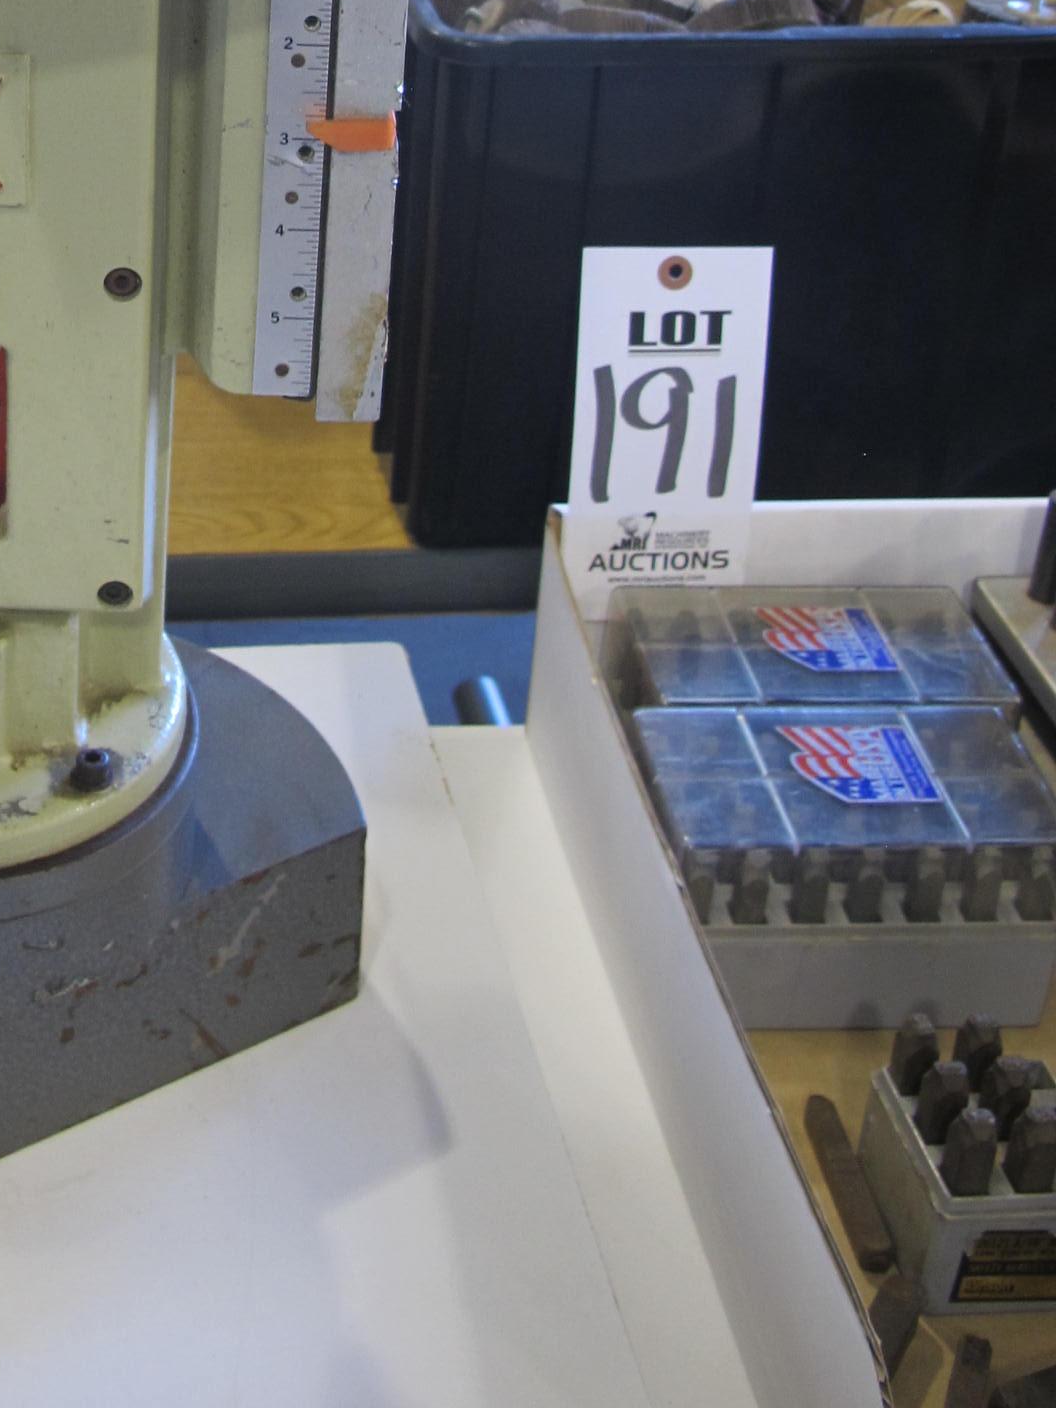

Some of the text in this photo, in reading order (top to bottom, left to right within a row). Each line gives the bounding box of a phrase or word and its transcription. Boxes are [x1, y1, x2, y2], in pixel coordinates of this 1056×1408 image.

[284, 37, 294, 51] 2
[280, 132, 290, 145] 3
[275, 224, 285, 237] 4
[270, 311, 281, 324] 5
[628, 310, 733, 346] LOT
[590, 365, 737, 503] 191
[589, 550, 729, 572] AUCTIONS
